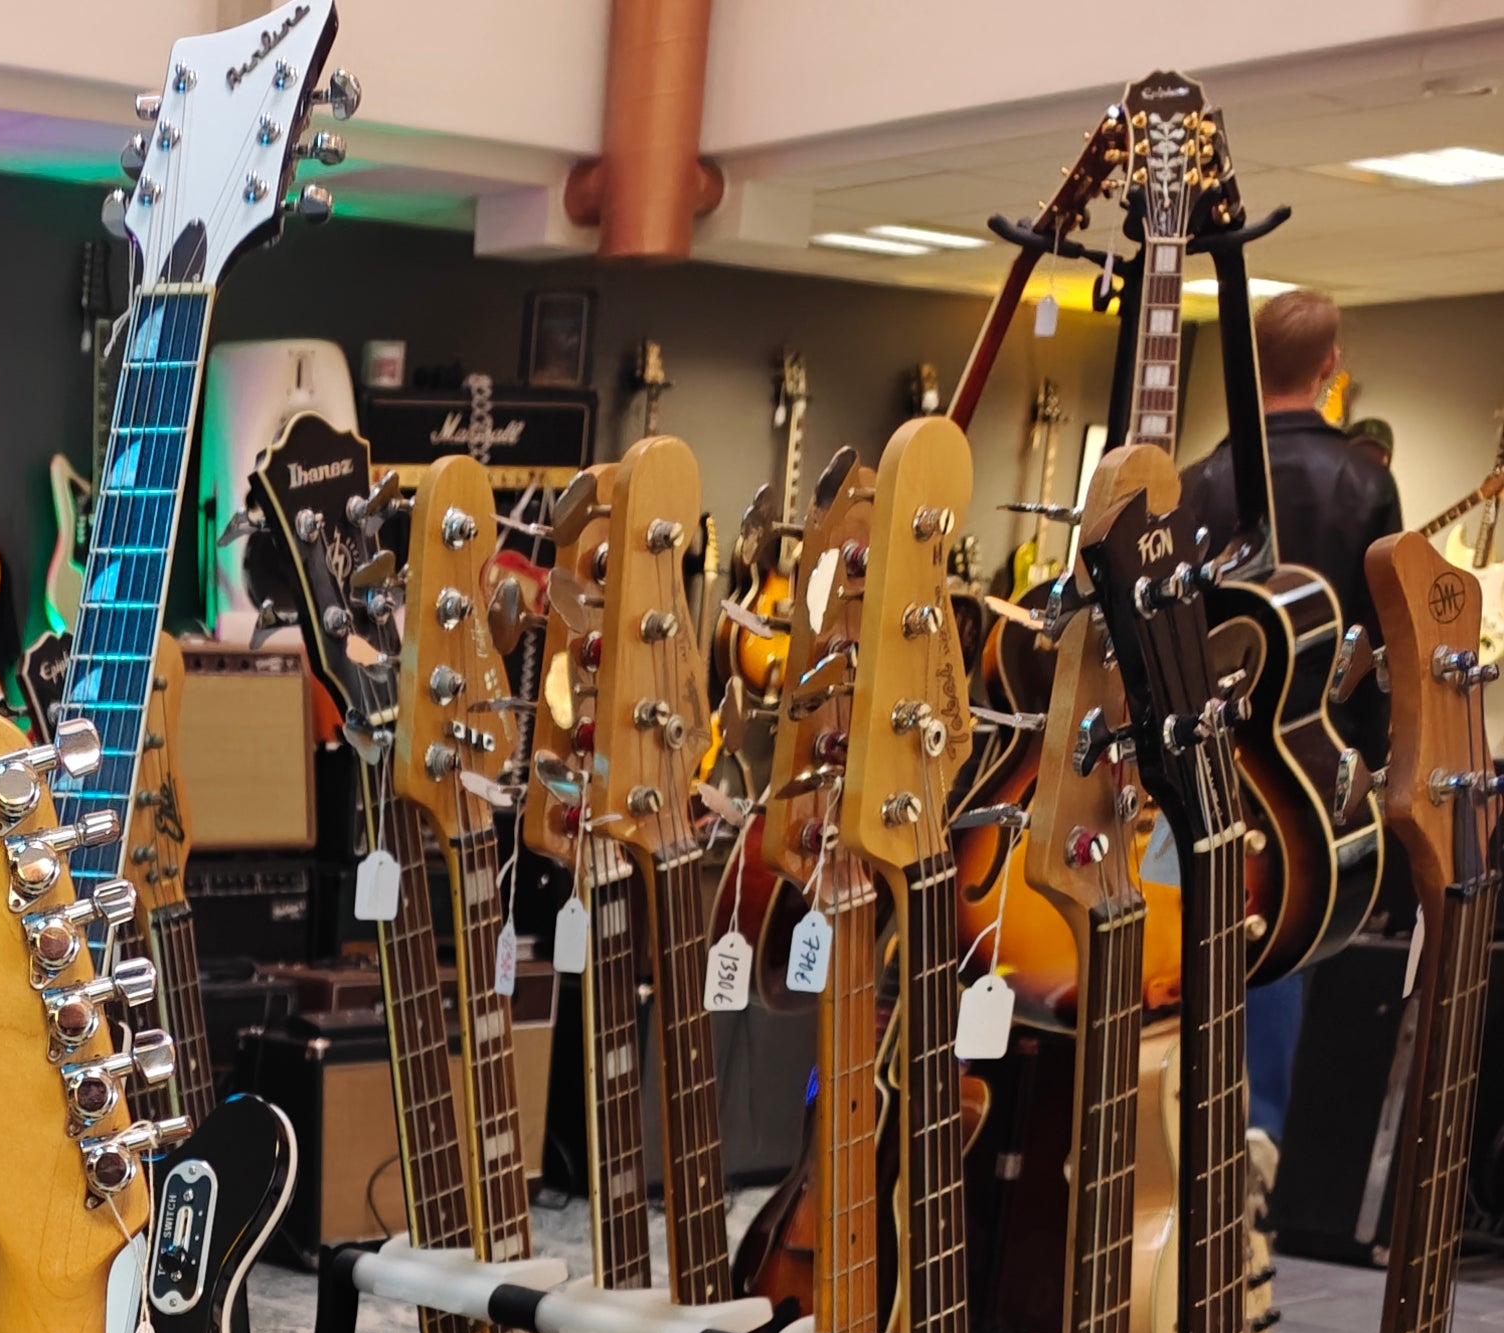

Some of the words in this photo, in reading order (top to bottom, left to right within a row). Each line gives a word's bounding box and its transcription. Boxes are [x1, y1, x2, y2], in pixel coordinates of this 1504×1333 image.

[287, 458, 354, 489] Ibanez
[1137, 527, 1174, 566] FGN
[163, 1194, 177, 1238] SWITCH
